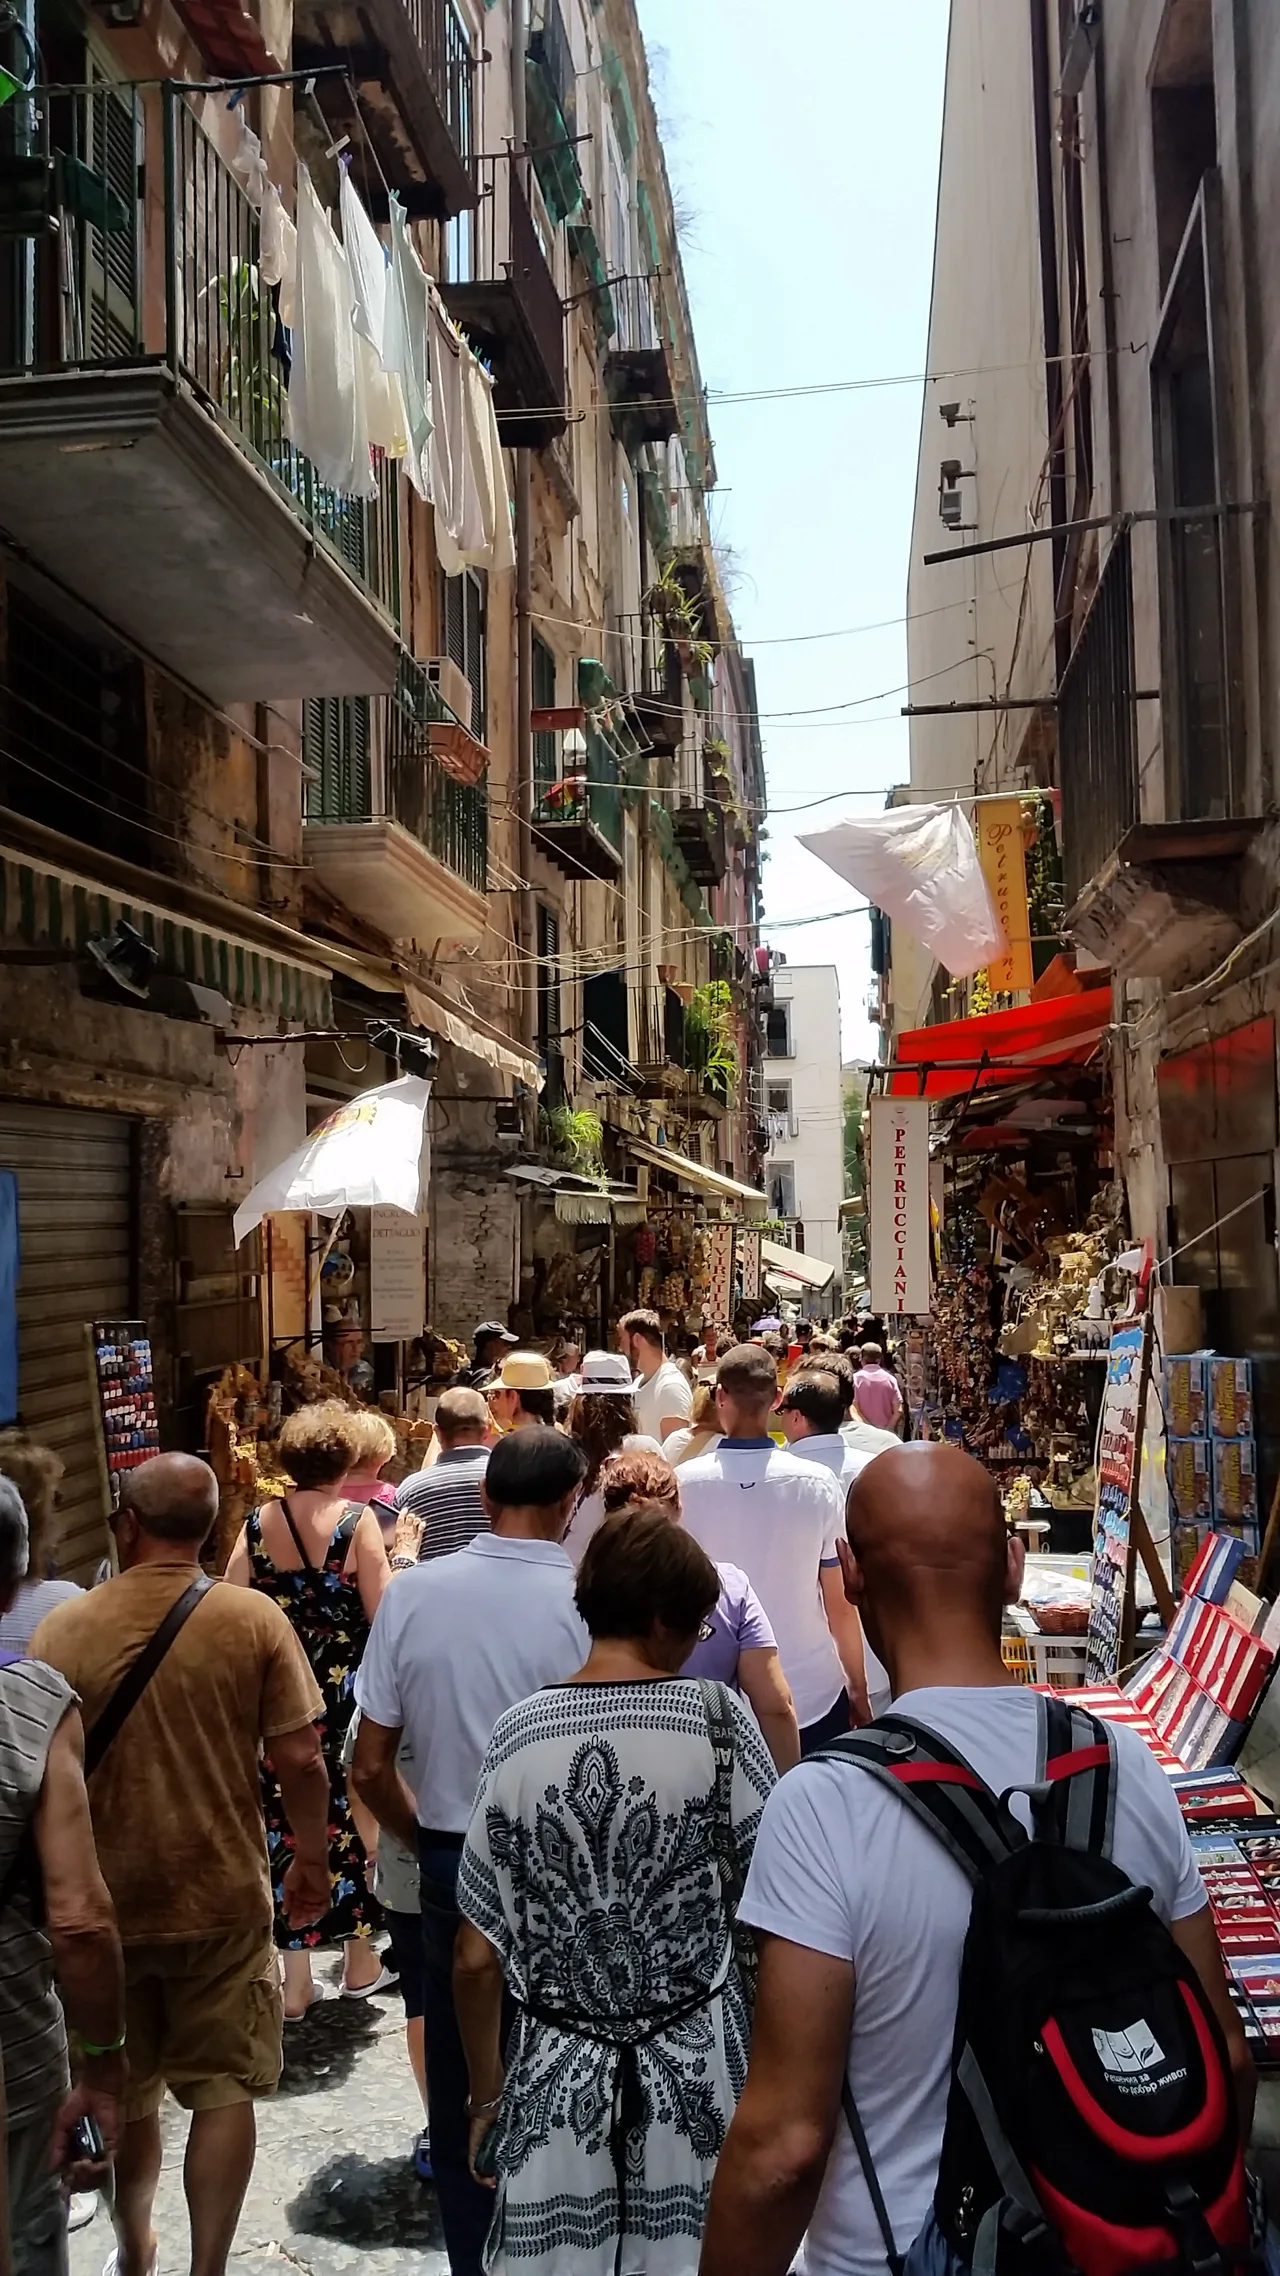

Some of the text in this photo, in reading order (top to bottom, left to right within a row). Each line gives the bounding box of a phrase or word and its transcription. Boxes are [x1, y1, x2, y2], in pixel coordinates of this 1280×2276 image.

[373, 1228, 421, 1238] DETTAGLIO
[894, 1128, 907, 1312] PETRUCCIANI
[711, 1224, 729, 1320] DI VIRGILIO
[745, 1231, 757, 1298] DI VIRGILIO
[1139, 2073, 1151, 2083] за
[1158, 2067, 1189, 2088] живот
